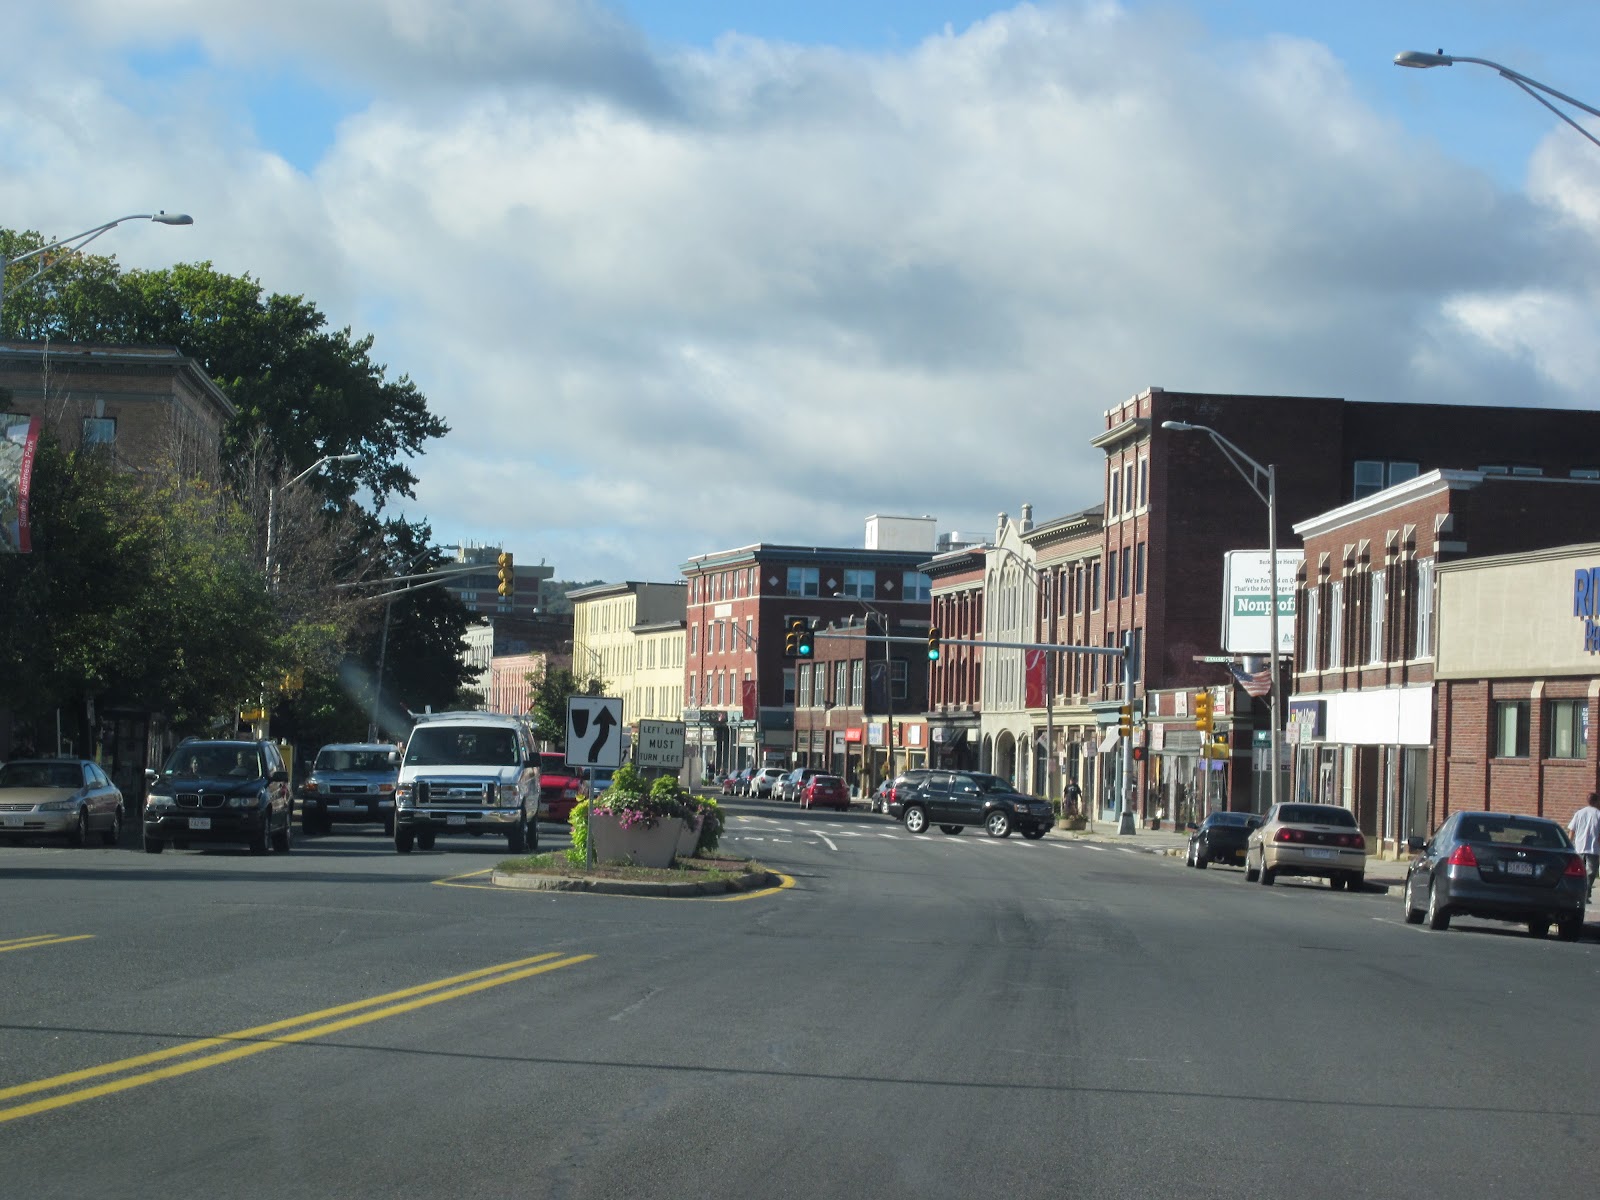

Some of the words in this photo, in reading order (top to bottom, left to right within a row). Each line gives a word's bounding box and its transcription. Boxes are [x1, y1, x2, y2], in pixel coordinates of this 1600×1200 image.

[25, 440, 34, 457] Park
[21, 460, 31, 496] Business
[20, 497, 28, 527] Stanley
[643, 726, 661, 734] LEFT
[665, 727, 684, 735] LANE
[649, 739, 675, 749] MUST
[640, 752, 658, 761] TURN
[662, 754, 679, 762] LEFT
